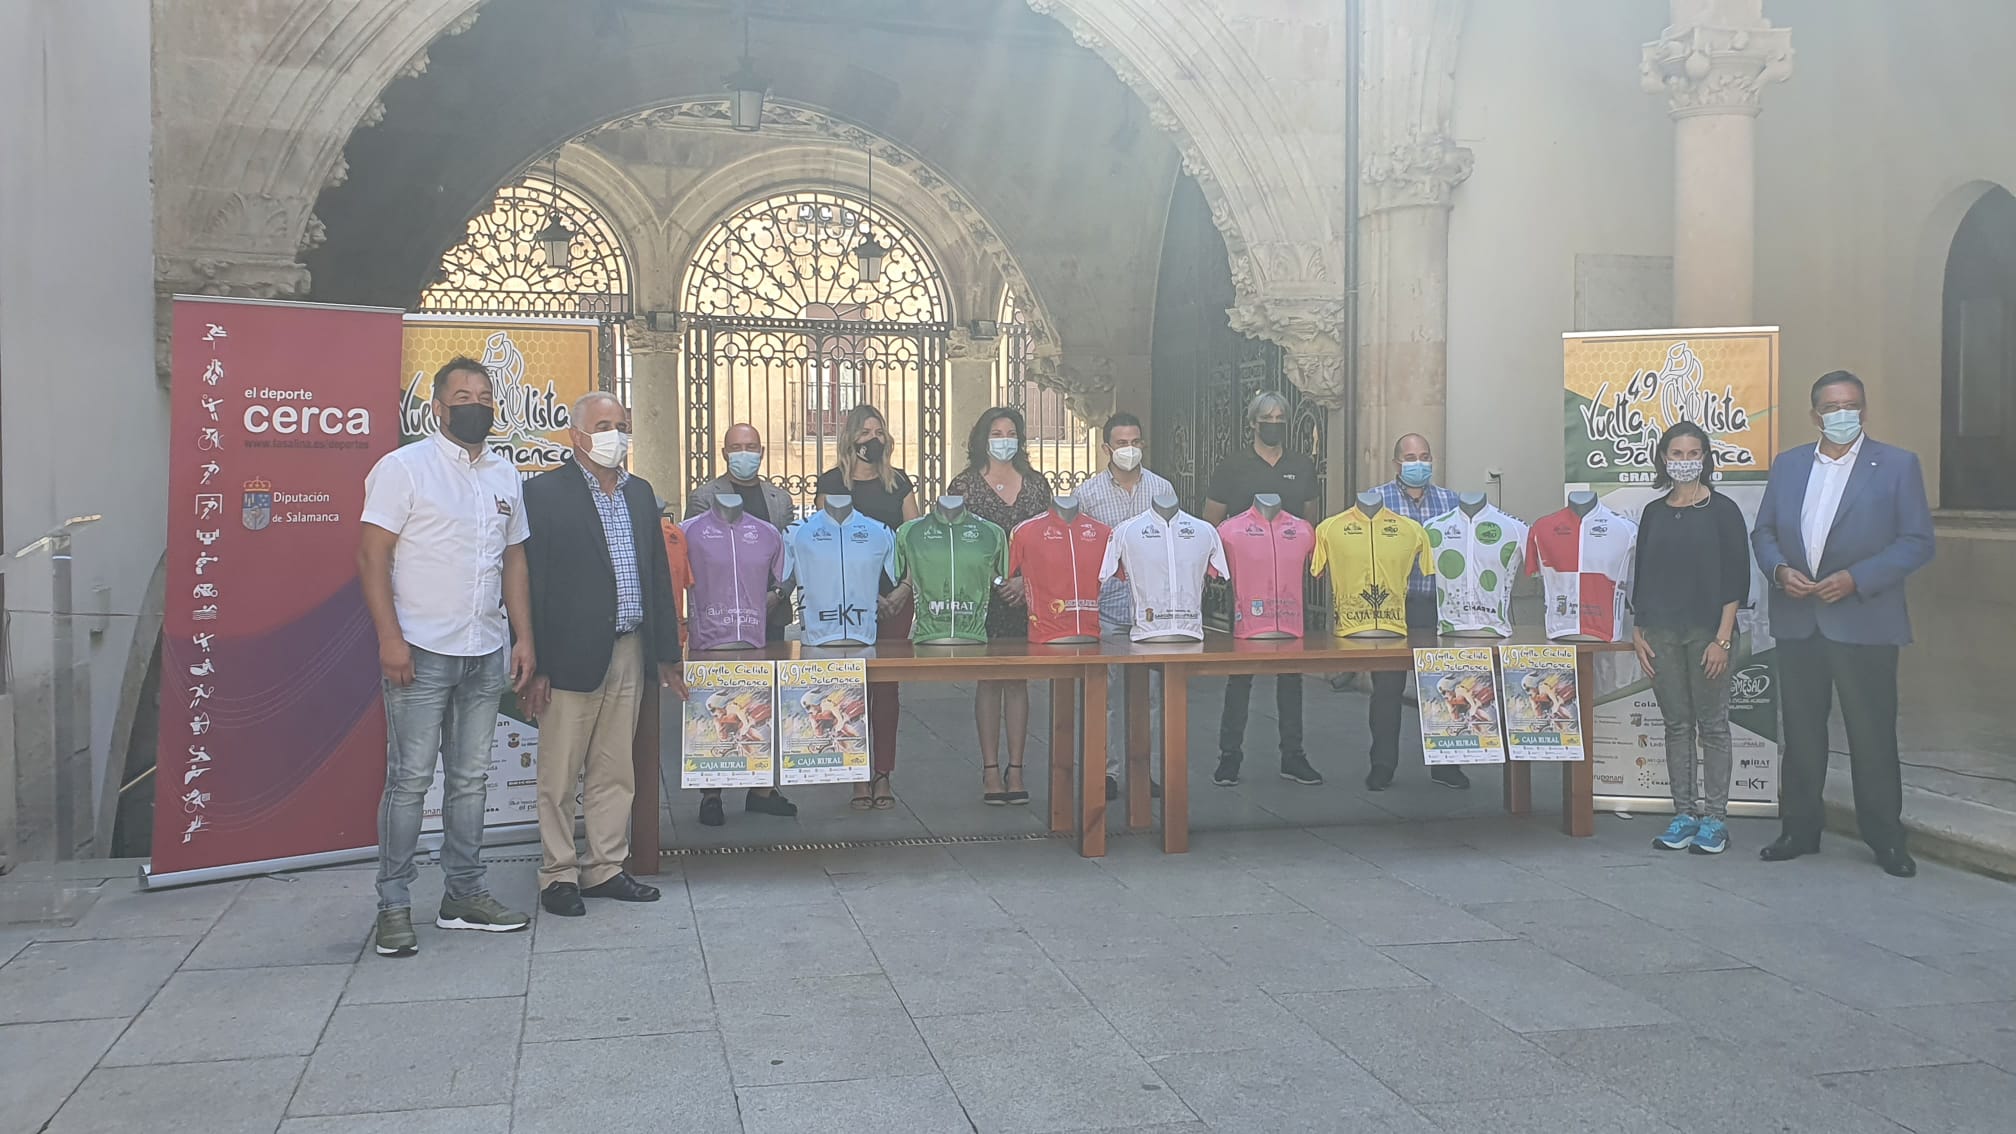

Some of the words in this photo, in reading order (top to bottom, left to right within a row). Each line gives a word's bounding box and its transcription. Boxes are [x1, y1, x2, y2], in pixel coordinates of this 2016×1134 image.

[1628, 371, 1658, 402] 49
[244, 387, 257, 398] el
[260, 388, 313, 401] deporte
[1582, 383, 1644, 439] Vuelta
[243, 405, 370, 435] cerca
[1589, 452, 1606, 466] a
[273, 491, 330, 505] Diputación
[272, 514, 283, 523] de
[286, 511, 339, 524] Salamanca
[1417, 652, 1433, 670] 49
[1503, 649, 1519, 665] 49
[687, 665, 706, 686] 49
[781, 664, 799, 683] 49
[1438, 740, 1454, 748] CAJA
[1521, 736, 1538, 744] CAJA
[700, 761, 718, 769] CAJA
[720, 761, 745, 769] RURAL
[797, 758, 816, 766] CAJA
[817, 757, 842, 765] RURAL
